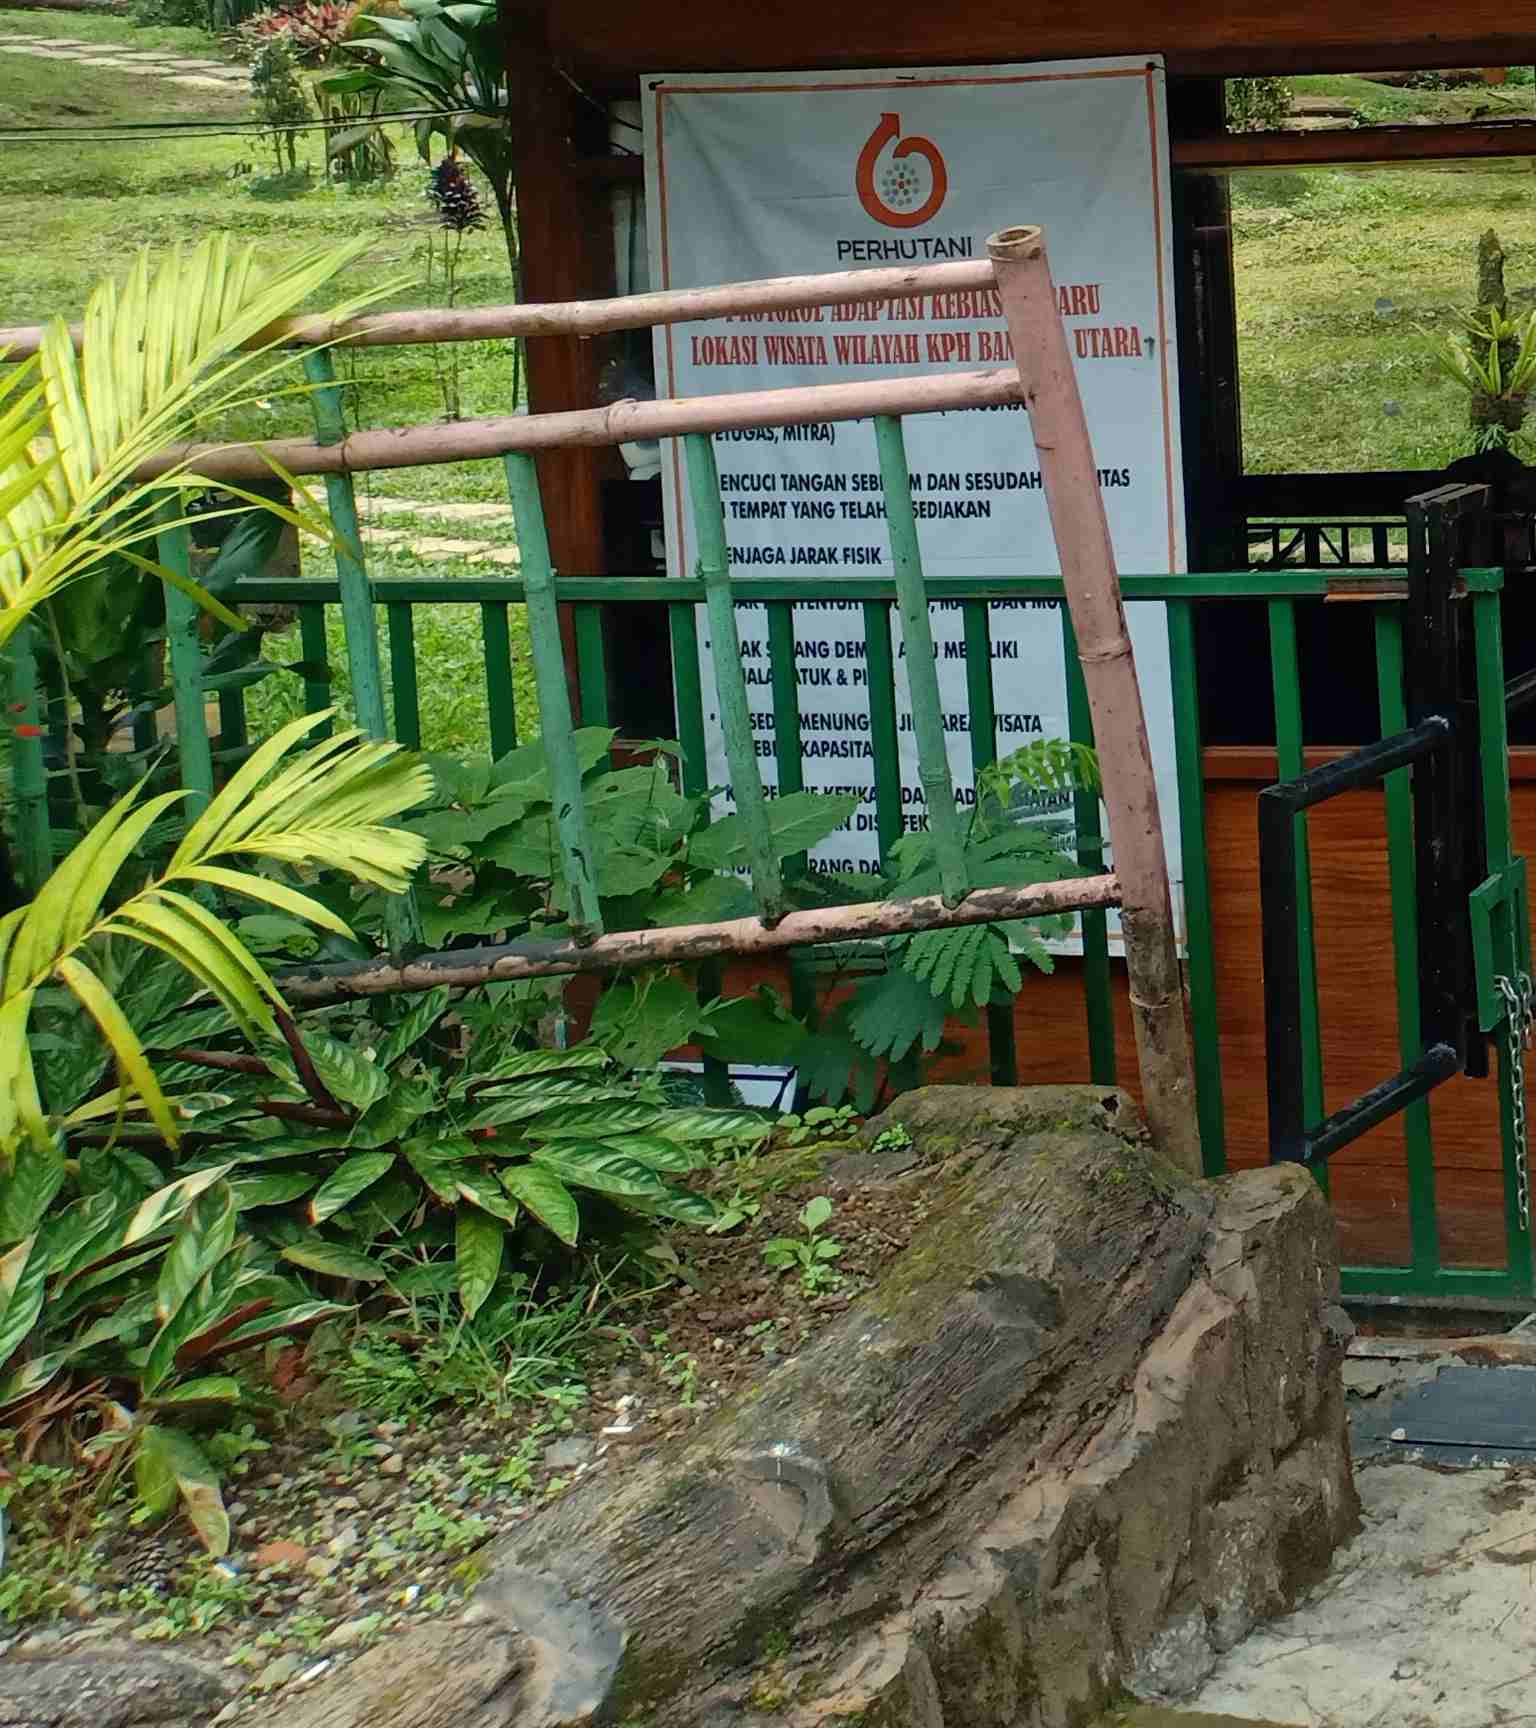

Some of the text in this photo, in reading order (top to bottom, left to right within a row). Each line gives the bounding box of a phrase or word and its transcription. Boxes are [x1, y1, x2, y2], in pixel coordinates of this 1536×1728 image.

[837, 237, 972, 261] PERHUTANI
[832, 294, 924, 322] ADAPTASI
[931, 287, 1005, 320] KEBIAS
[1059, 284, 1101, 316] ARU
[691, 335, 758, 366] LOKASI
[762, 334, 829, 366] WISATA
[832, 332, 920, 365] WILAYAH
[926, 331, 971, 363] KPH
[1072, 326, 1142, 359] UTARA
[716, 423, 835, 445] ETUGAS, MITRA)
[720, 473, 777, 492] ENCUCI
[781, 472, 847, 491] TANGAN
[851, 472, 922, 491] SEBM
[927, 472, 960, 491] DAN
[965, 471, 1042, 490] SESUDAH
[731, 501, 787, 519] TEMPAT
[792, 500, 835, 519] YANG
[839, 500, 887, 519] TELAH
[911, 499, 991, 519] SEDIAKAN
[727, 546, 882, 565] ENJAGA JARAK FISIK
[834, 640, 867, 659] DEM
[836, 668, 848, 686] &
[800, 713, 869, 731] MENUNG
[801, 739, 874, 758] KAPASITA
